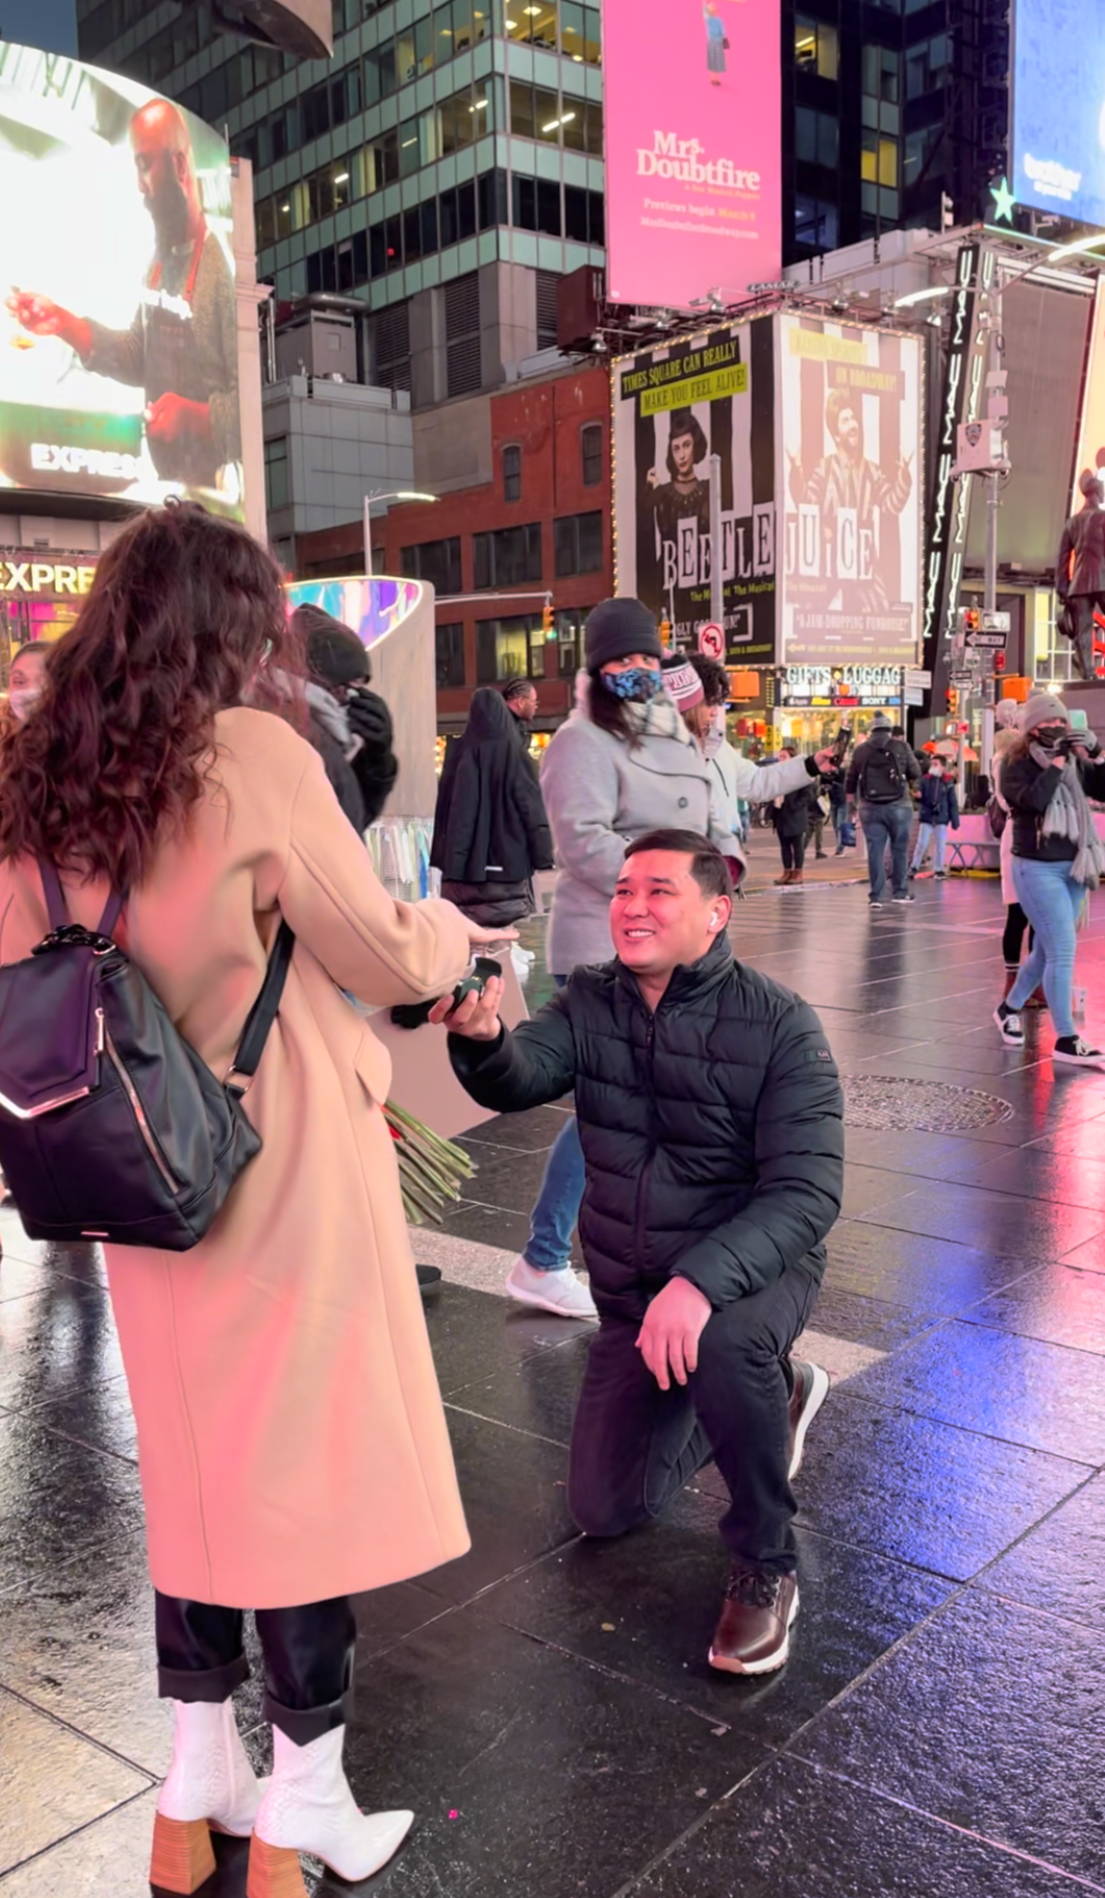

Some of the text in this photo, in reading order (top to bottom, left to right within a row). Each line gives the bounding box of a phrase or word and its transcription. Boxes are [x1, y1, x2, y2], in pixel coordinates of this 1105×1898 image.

[653, 130, 704, 158] Mrs.
[637, 149, 760, 190] Doubtfire
[622, 340, 738, 393] TIMES SQUARE CAN REALLY
[644, 367, 745, 410] MAKE YOU FEEL ALIVE!
[663, 512, 774, 590] BEETLE
[786, 667, 831, 685] GIFTS
